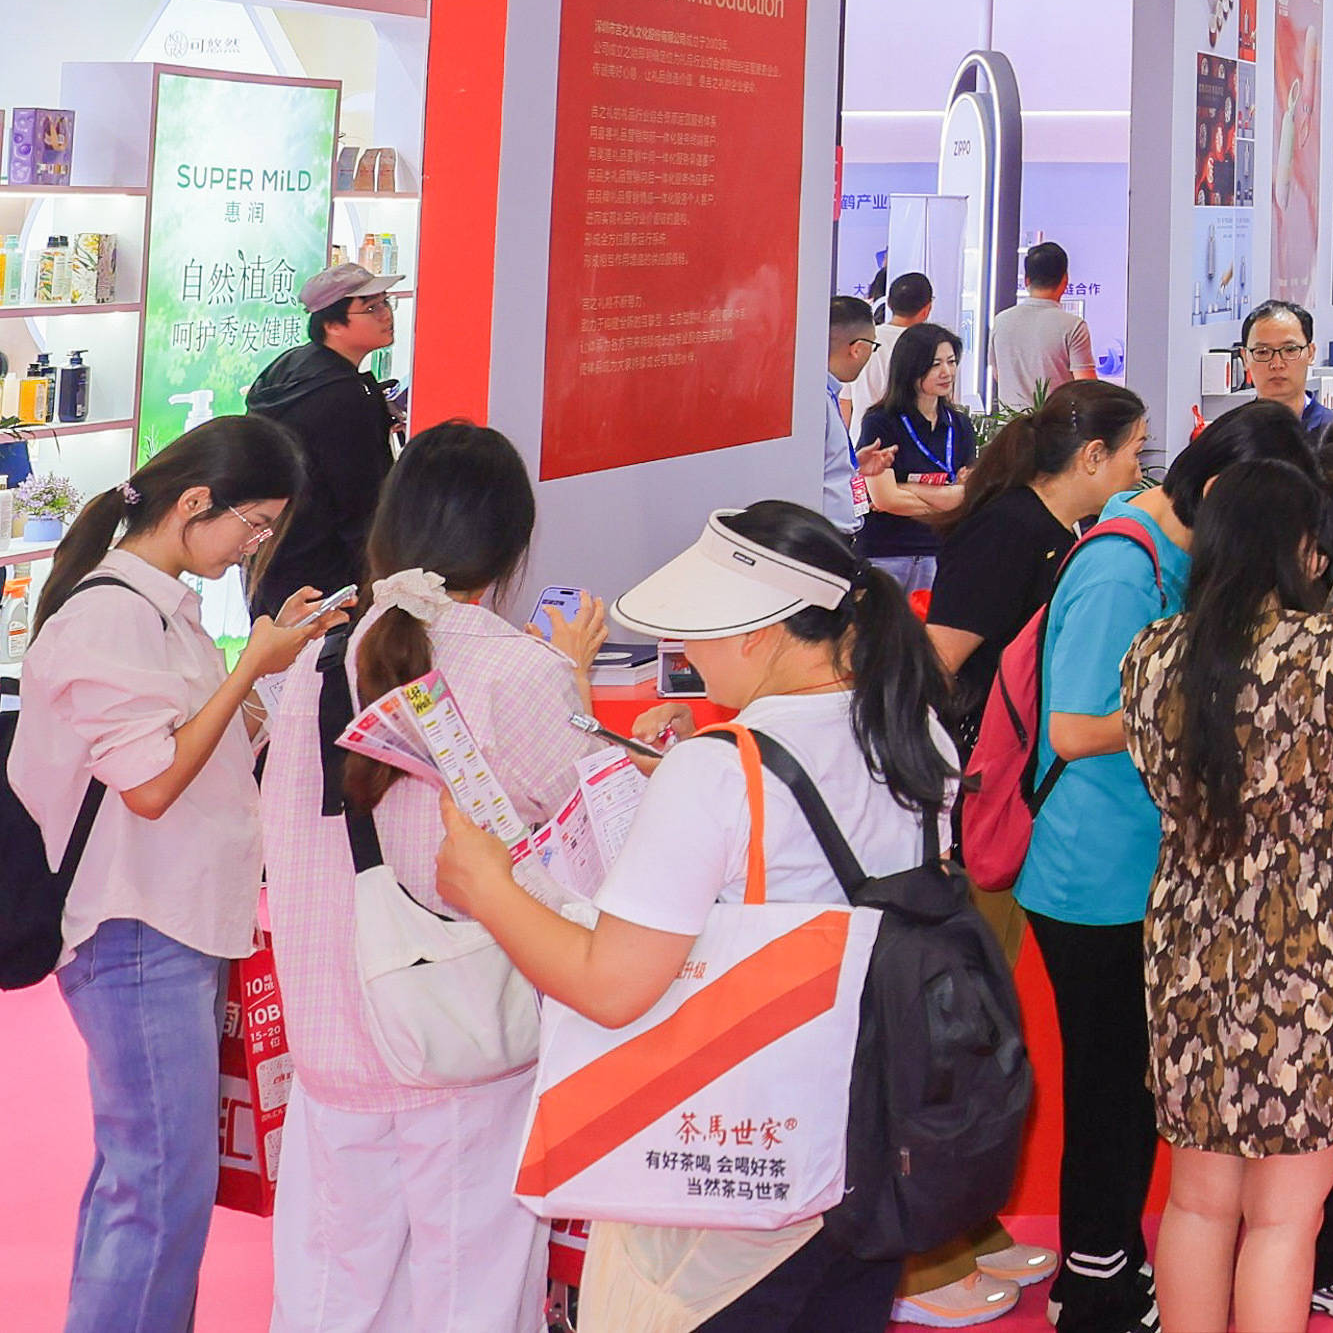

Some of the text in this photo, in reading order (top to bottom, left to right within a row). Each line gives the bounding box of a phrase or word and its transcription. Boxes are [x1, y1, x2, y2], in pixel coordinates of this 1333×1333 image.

[177, 164, 254, 191] SUPER
[224, 200, 265, 223] 惠润
[182, 252, 298, 306] 自然植愈
[172, 315, 301, 355] 呵护秀发健康
[645, 1150, 786, 1178] 有好茶喝 会喝好茶
[687, 1176, 791, 1202] 当然茶马世家
